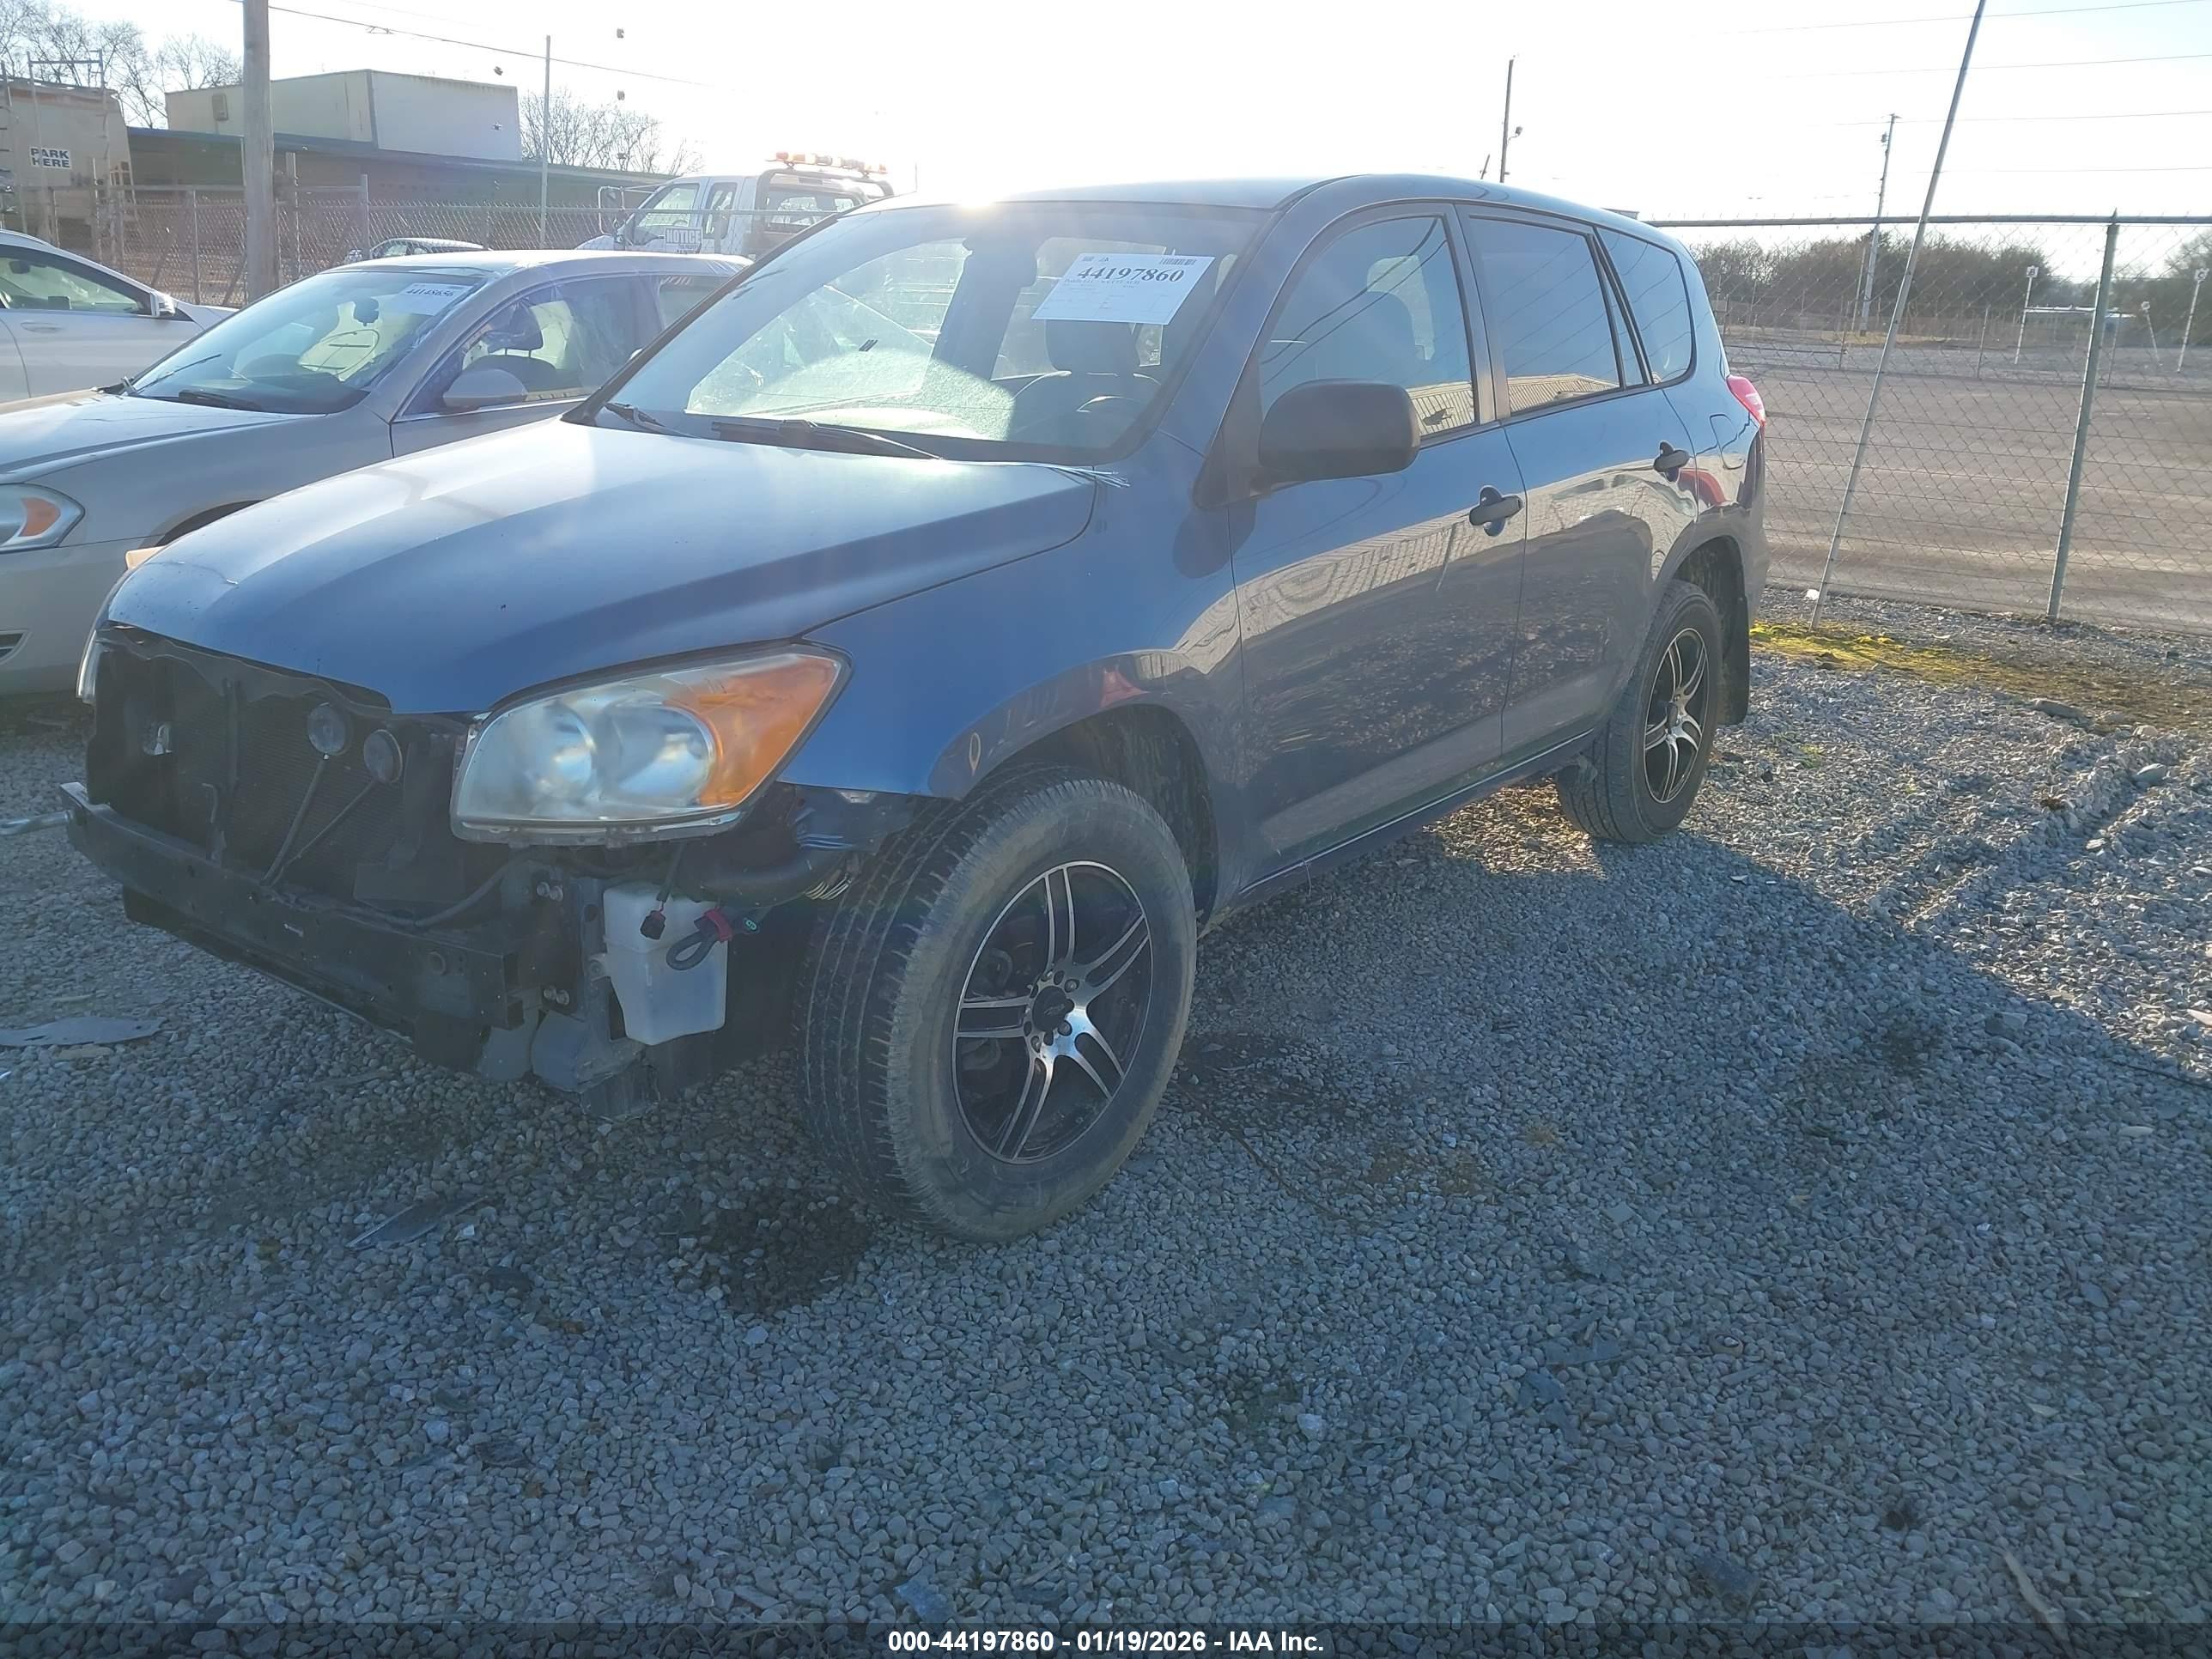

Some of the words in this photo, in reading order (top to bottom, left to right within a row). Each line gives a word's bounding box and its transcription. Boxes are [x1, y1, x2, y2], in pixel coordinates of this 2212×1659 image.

[31, 148, 69, 159] PARK
[32, 157, 70, 167] HERE
[666, 228, 701, 244] NOTICE
[1078, 266, 1185, 283] 44197860
